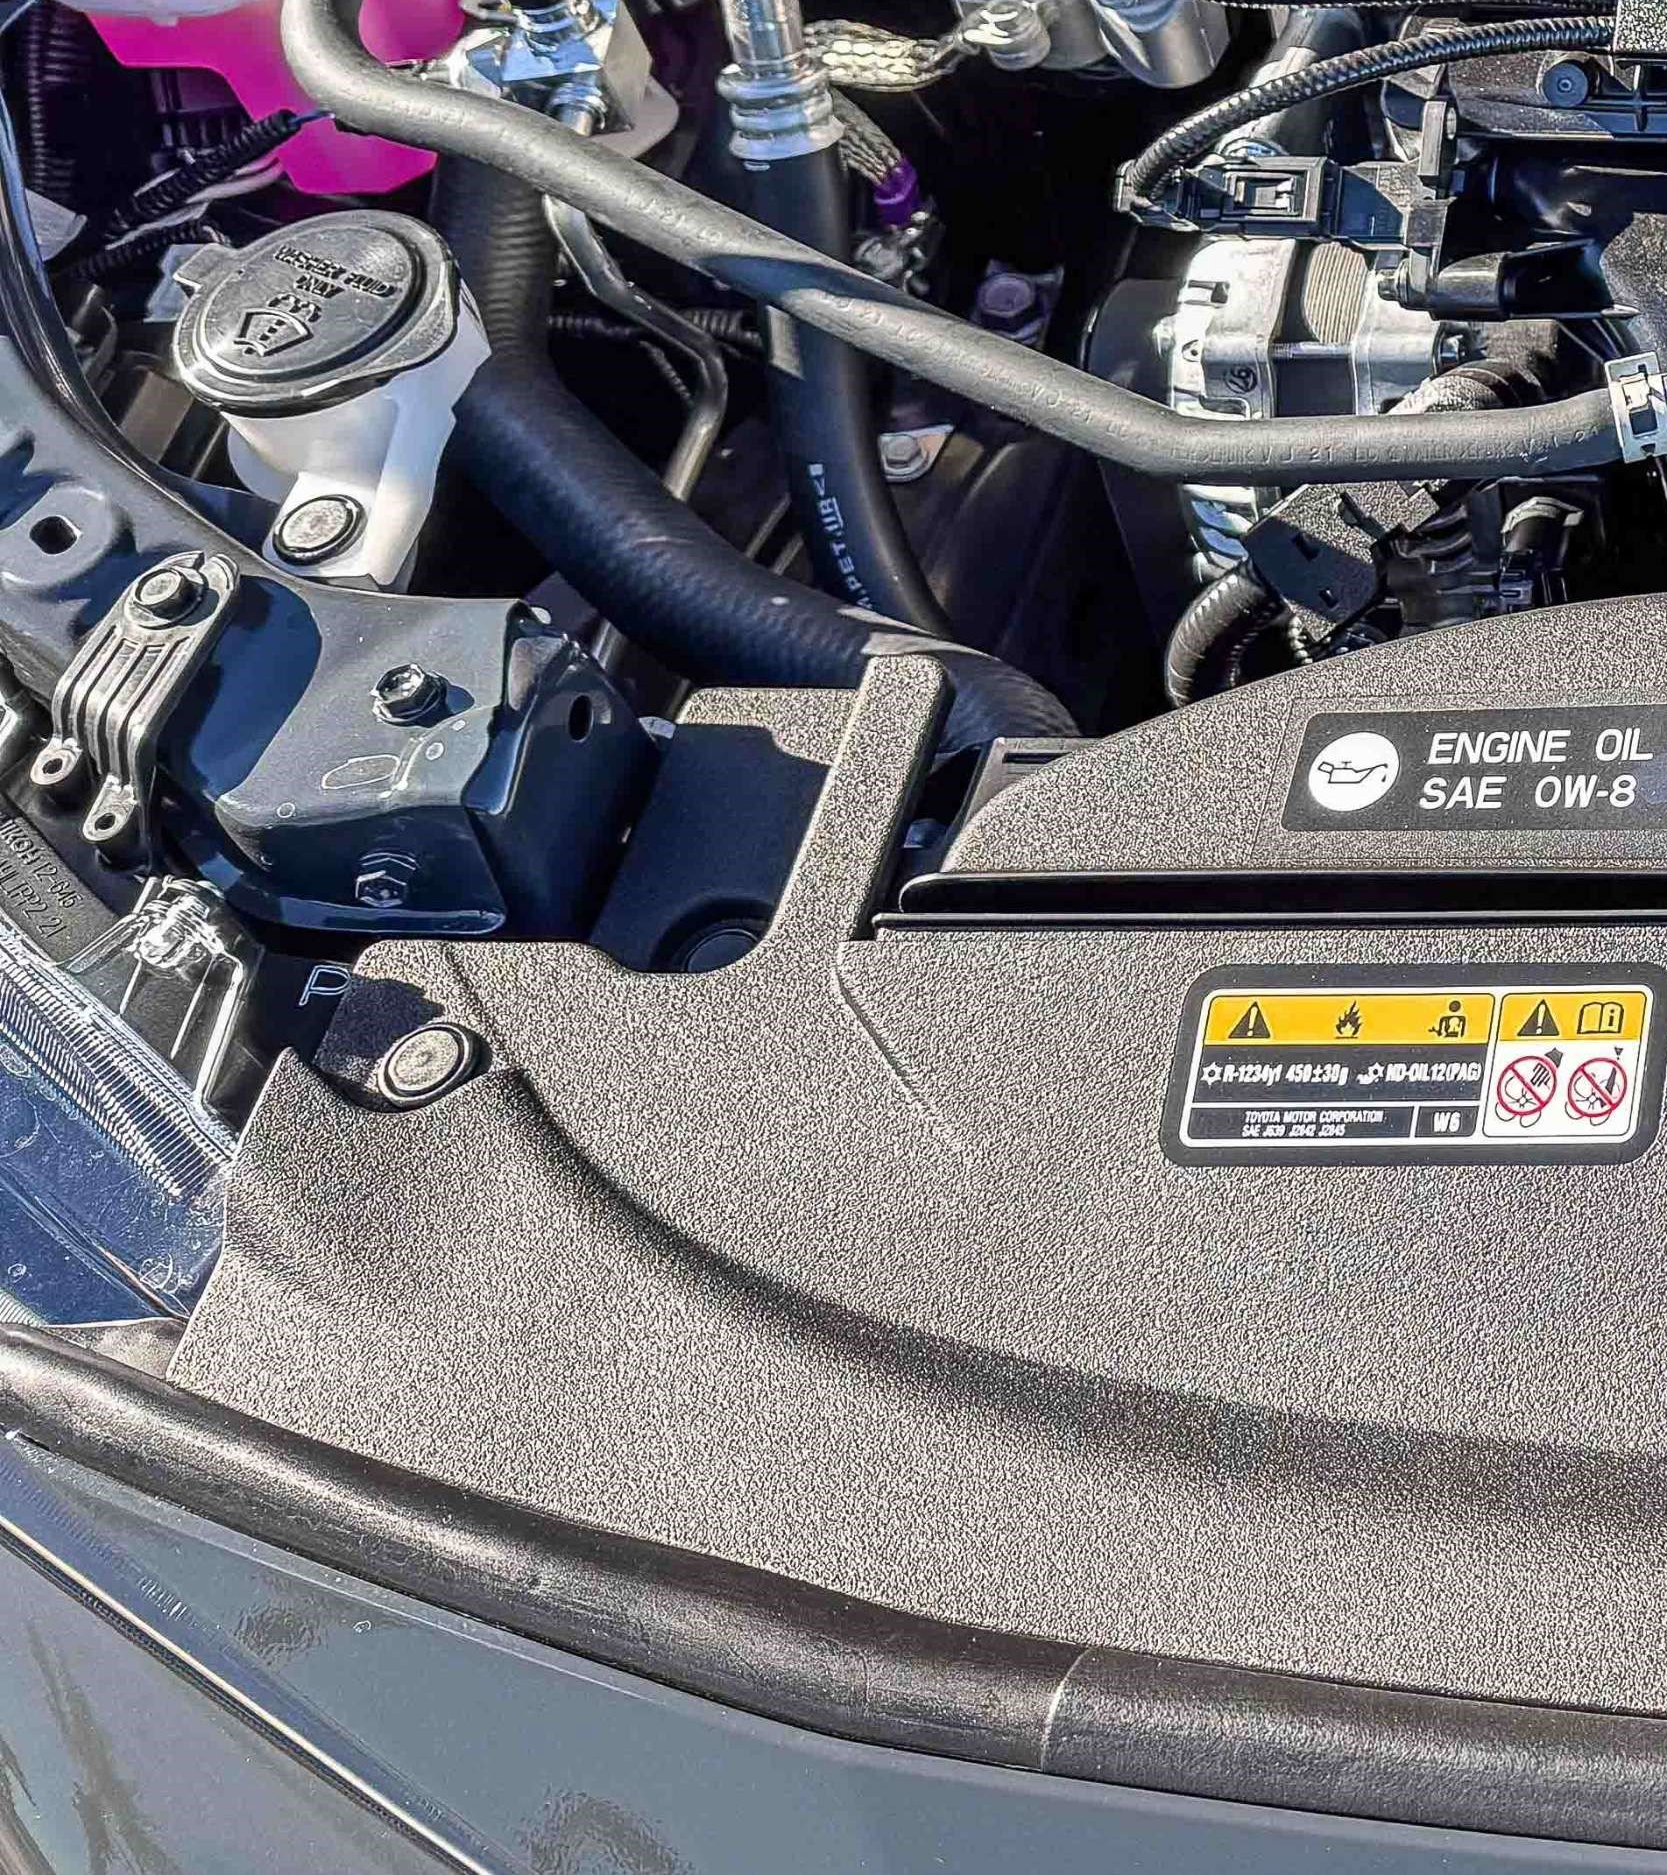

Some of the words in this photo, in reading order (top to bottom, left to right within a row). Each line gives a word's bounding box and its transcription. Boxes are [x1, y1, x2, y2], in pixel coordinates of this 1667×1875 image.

[1427, 728, 1571, 765] ENGINE
[1595, 727, 1654, 762] OIL
[1419, 774, 1507, 810] SAE
[1534, 773, 1637, 809] 0W-8
[299, 964, 351, 1006] P
[1242, 1125, 1260, 1137] SAE
[1245, 1110, 1280, 1123] TOYOTA
[1283, 1110, 1316, 1123] MOTOR
[1320, 1110, 1384, 1123] CORPORATION
[1433, 1111, 1461, 1132] W6
